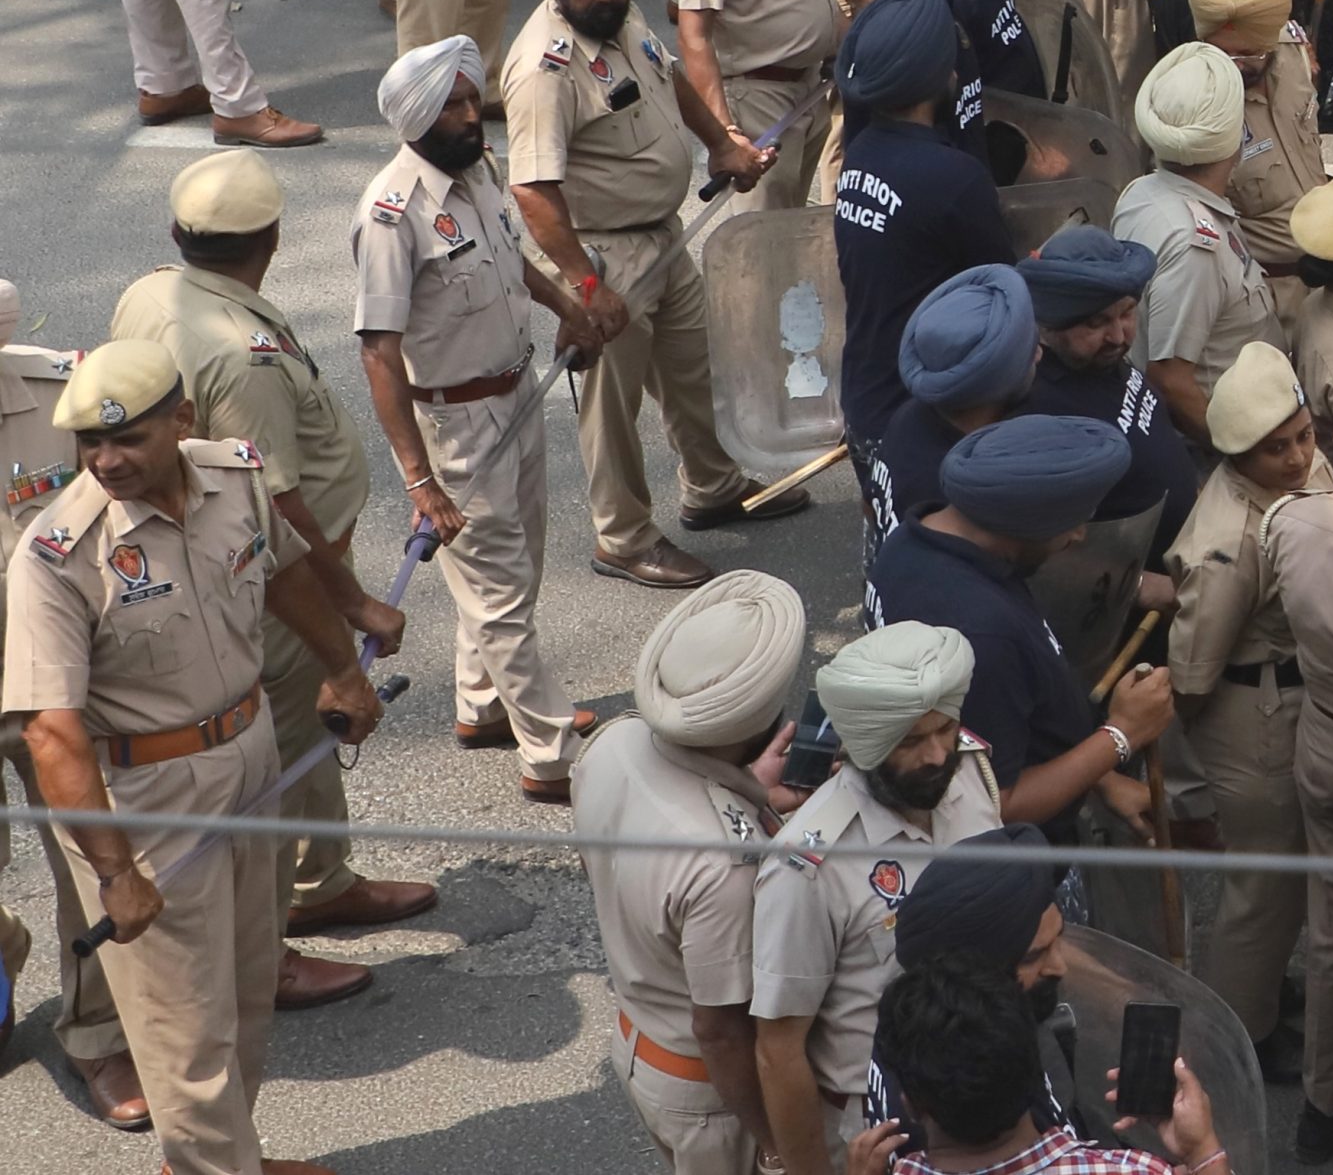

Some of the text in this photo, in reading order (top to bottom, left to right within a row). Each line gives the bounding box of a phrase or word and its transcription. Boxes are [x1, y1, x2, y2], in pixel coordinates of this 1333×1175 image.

[837, 197, 888, 234] POLICE
[862, 172, 903, 217] RIOT
[1138, 389, 1158, 437] POLICE
